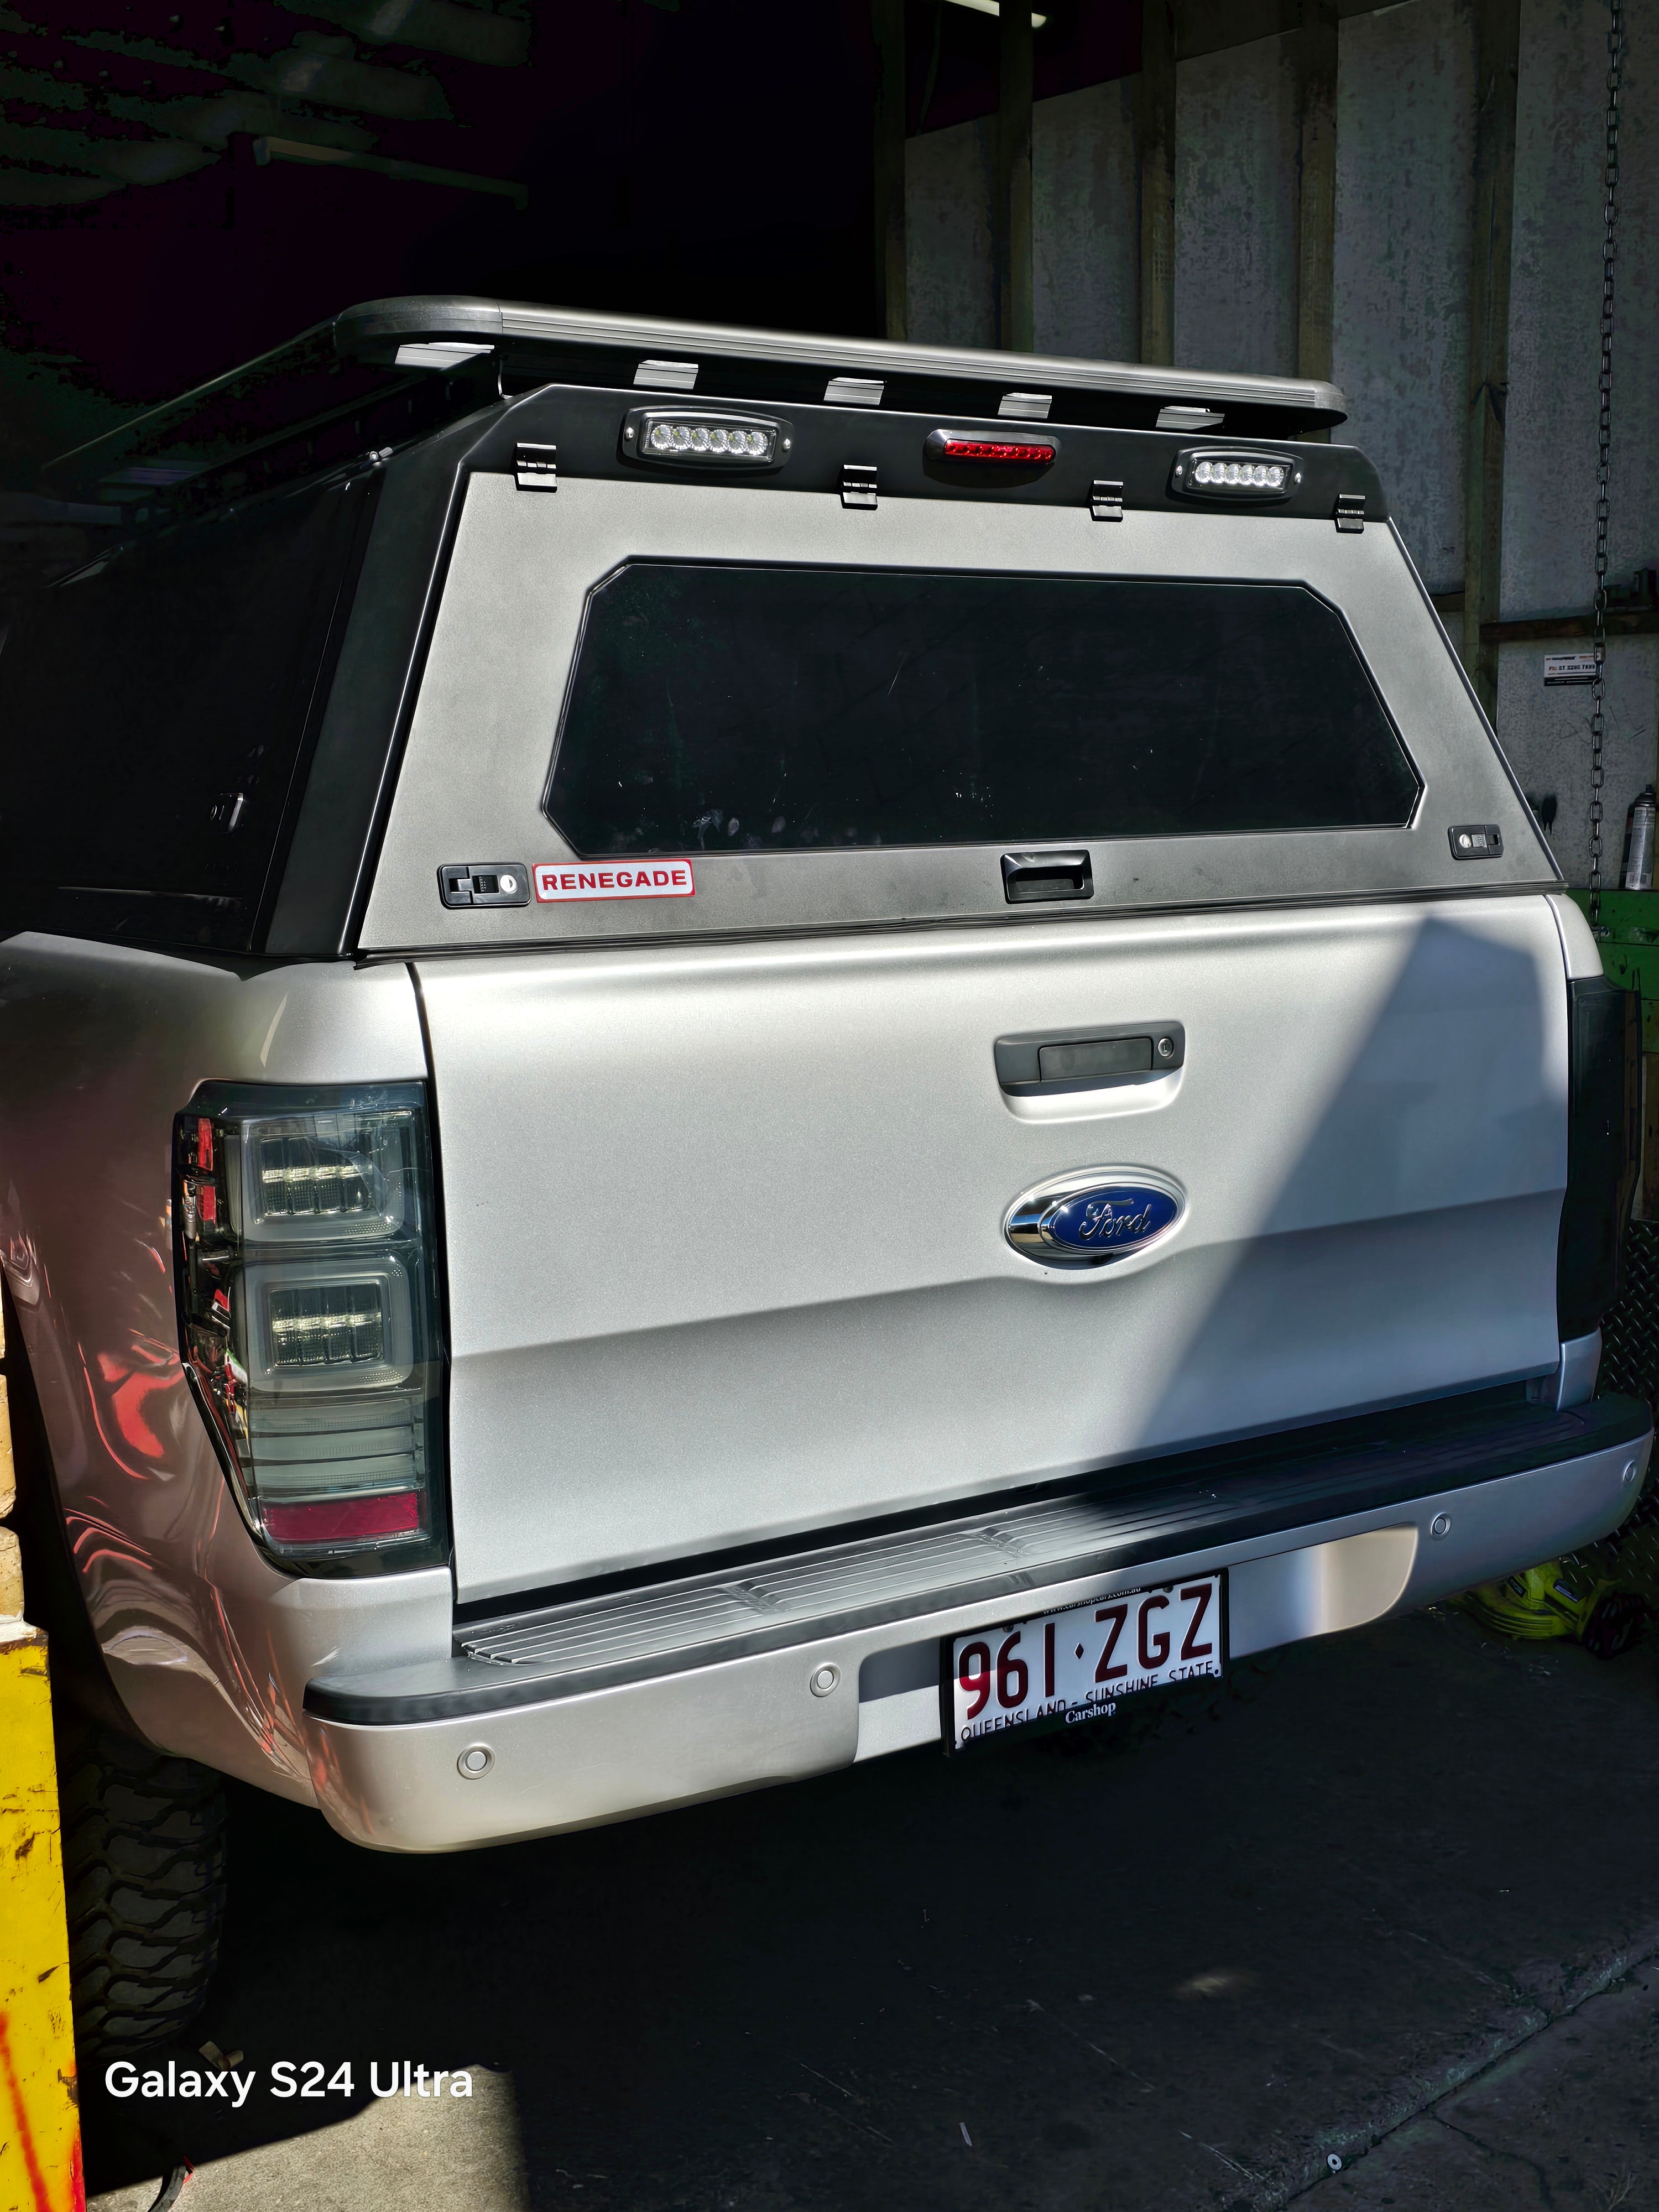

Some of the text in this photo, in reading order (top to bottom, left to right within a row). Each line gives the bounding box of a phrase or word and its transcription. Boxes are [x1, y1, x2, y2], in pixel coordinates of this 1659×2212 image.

[541, 869, 687, 890] RENEGADE
[1078, 1198, 1152, 1240] Ford
[959, 1583, 1212, 1720] 961 ZGZ
[961, 1699, 1066, 1741] QUEENSLAND
[1086, 1674, 1159, 1703] SUNSHINE
[1168, 1661, 1213, 1682] STATE
